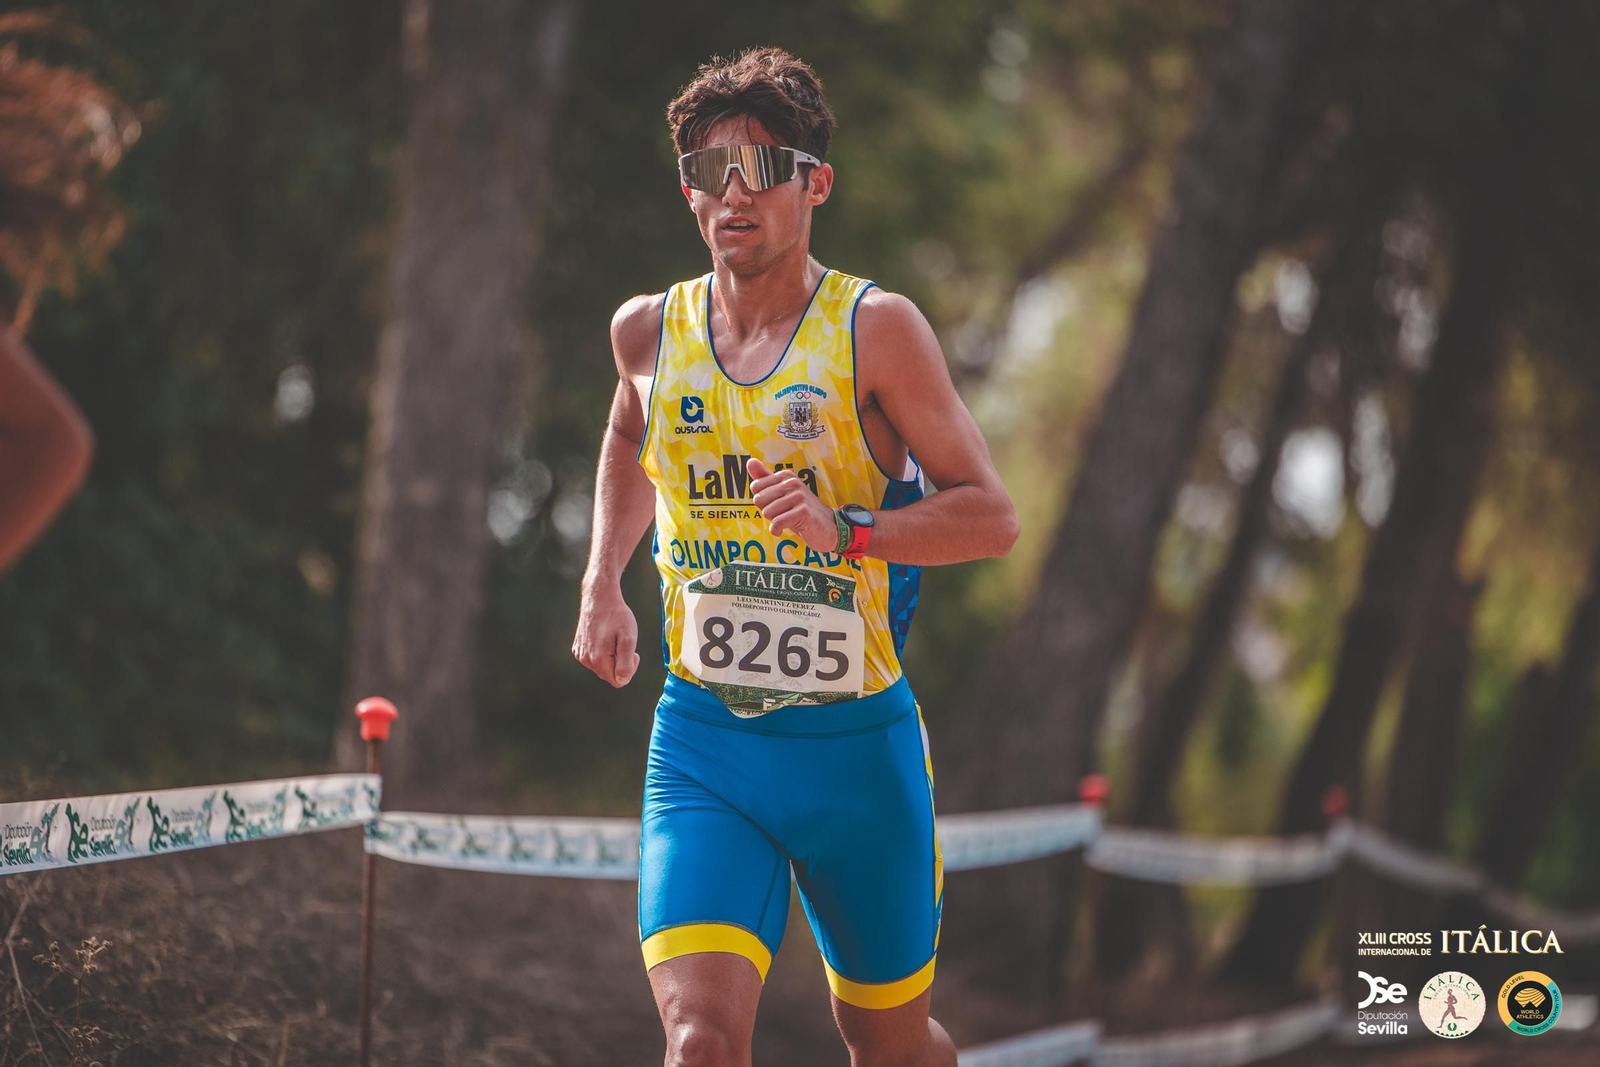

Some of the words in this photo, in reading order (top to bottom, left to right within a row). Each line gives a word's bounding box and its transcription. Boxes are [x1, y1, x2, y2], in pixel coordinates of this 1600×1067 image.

[690, 510, 704, 519] SE
[708, 510, 750, 519] SIENTA
[671, 539, 765, 570] OLIMPO
[735, 568, 818, 592] ITÁLICA
[731, 602, 778, 613] POLIDEPORTIVO
[779, 607, 802, 616] OLIMPO
[753, 597, 791, 608] MARTINEZ
[792, 603, 816, 611] PEREZ
[699, 616, 849, 681] 8265
